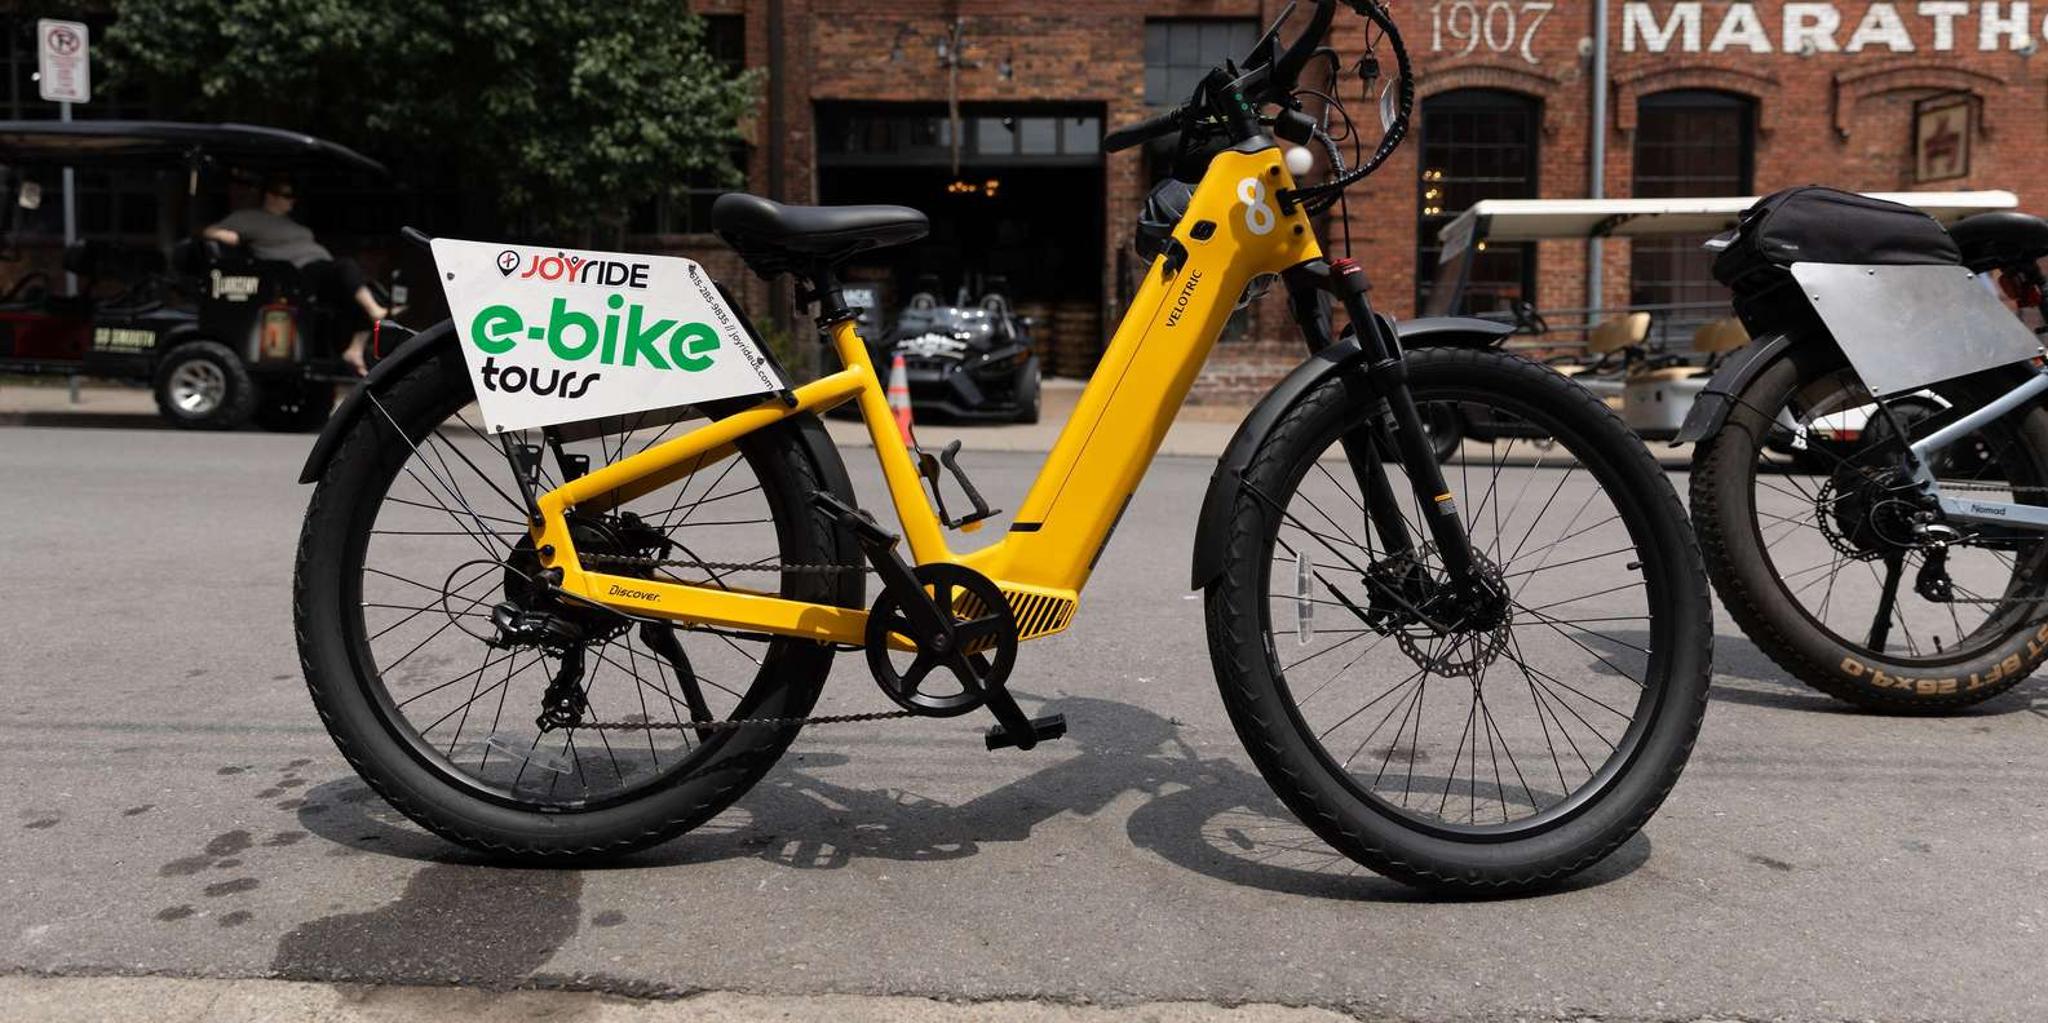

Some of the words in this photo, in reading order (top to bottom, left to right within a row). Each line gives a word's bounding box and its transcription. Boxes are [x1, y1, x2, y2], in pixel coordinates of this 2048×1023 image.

[1430, 0, 1554, 64] 1907
[1622, 2, 2048, 54] MARATH
[1237, 177, 1275, 235] 8
[1166, 269, 1202, 328] VELOTRIC
[471, 294, 721, 373] e-bike
[689, 271, 730, 325] 615-285-9835
[729, 330, 774, 390] joyrideus.com
[481, 357, 601, 399] tours
[1971, 504, 2006, 516] Nomad
[1840, 657, 1958, 694] 26x4.0
[1967, 653, 2022, 691] BFT
